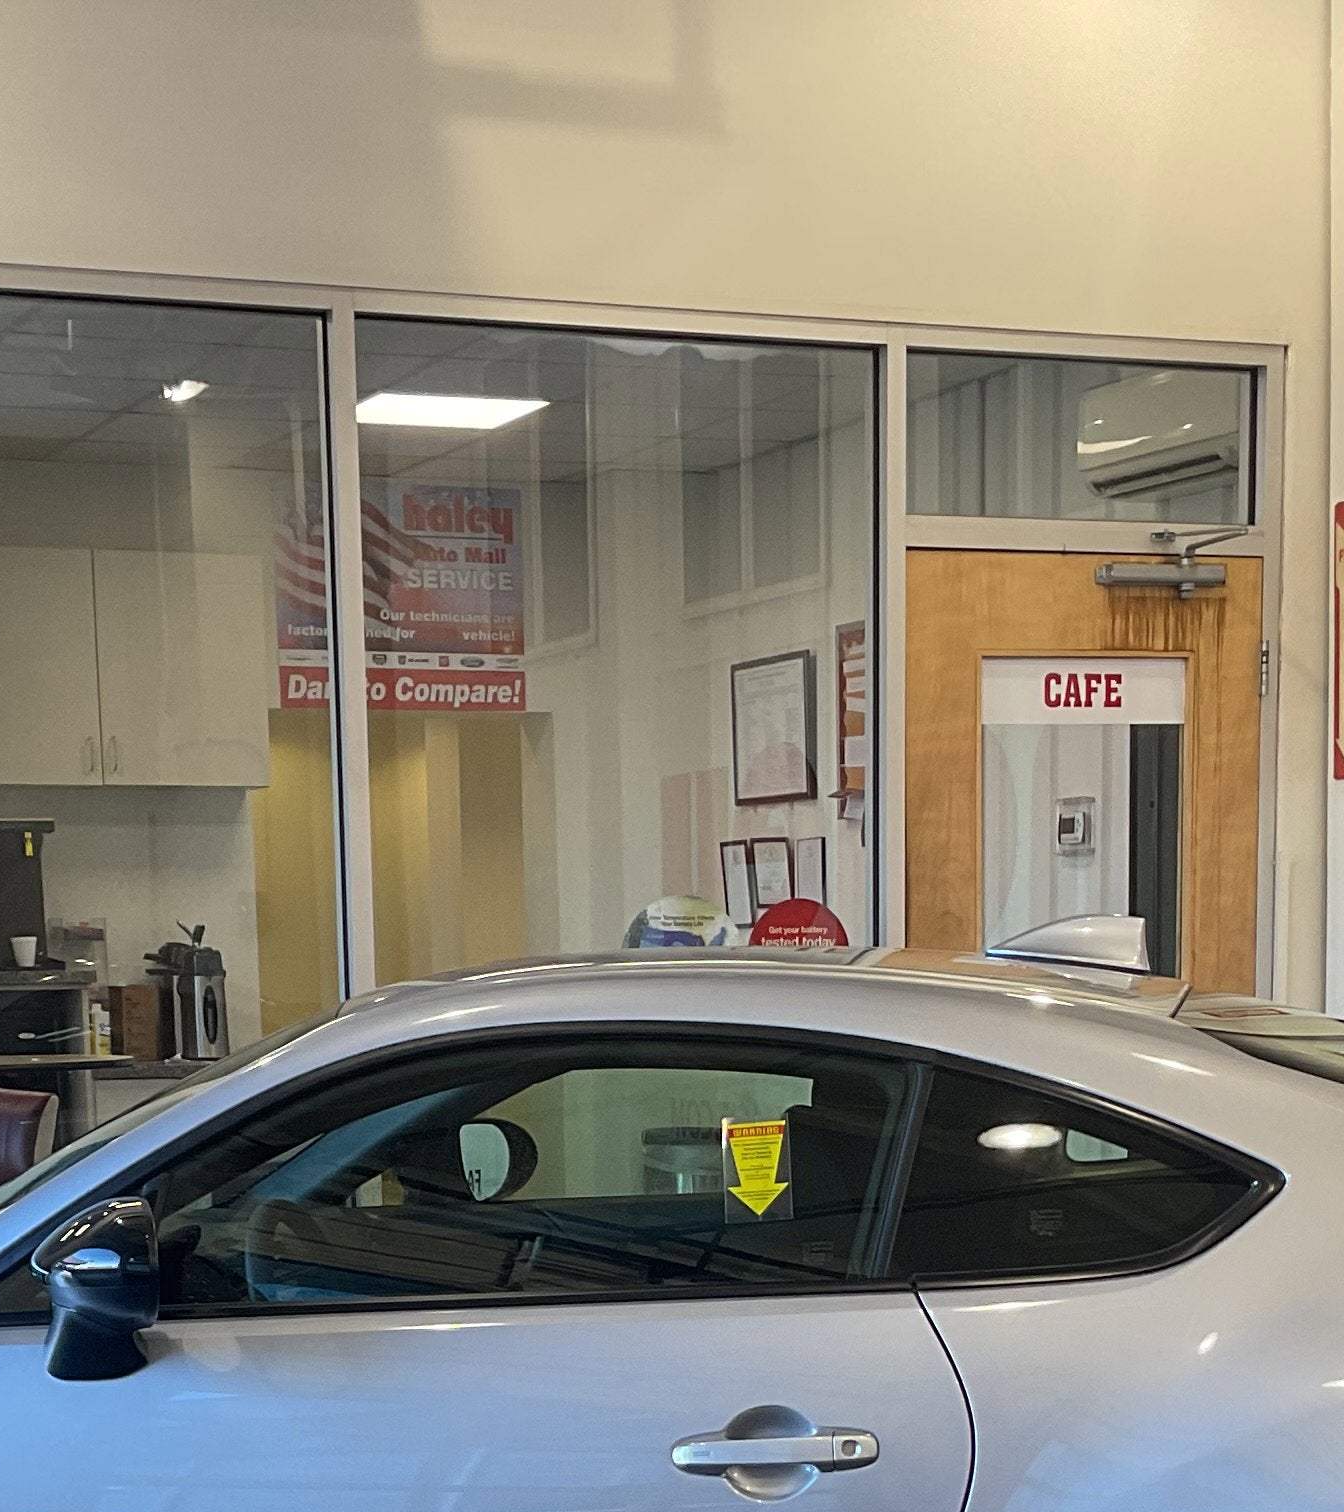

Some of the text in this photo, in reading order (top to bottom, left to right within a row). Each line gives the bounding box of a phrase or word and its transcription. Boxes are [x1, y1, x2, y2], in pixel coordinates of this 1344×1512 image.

[403, 494, 513, 545] haley
[465, 547, 506, 564] Mall
[407, 569, 513, 591] SERVICE
[380, 609, 514, 625] Our technicians are
[288, 623, 328, 636] factor
[462, 629, 514, 642] vehicle!
[395, 676, 522, 708] Compare!
[1044, 672, 1122, 708] CAFE
[768, 926, 828, 936] Get your battery
[761, 936, 799, 946] tested
[732, 1126, 779, 1137] WARNING
